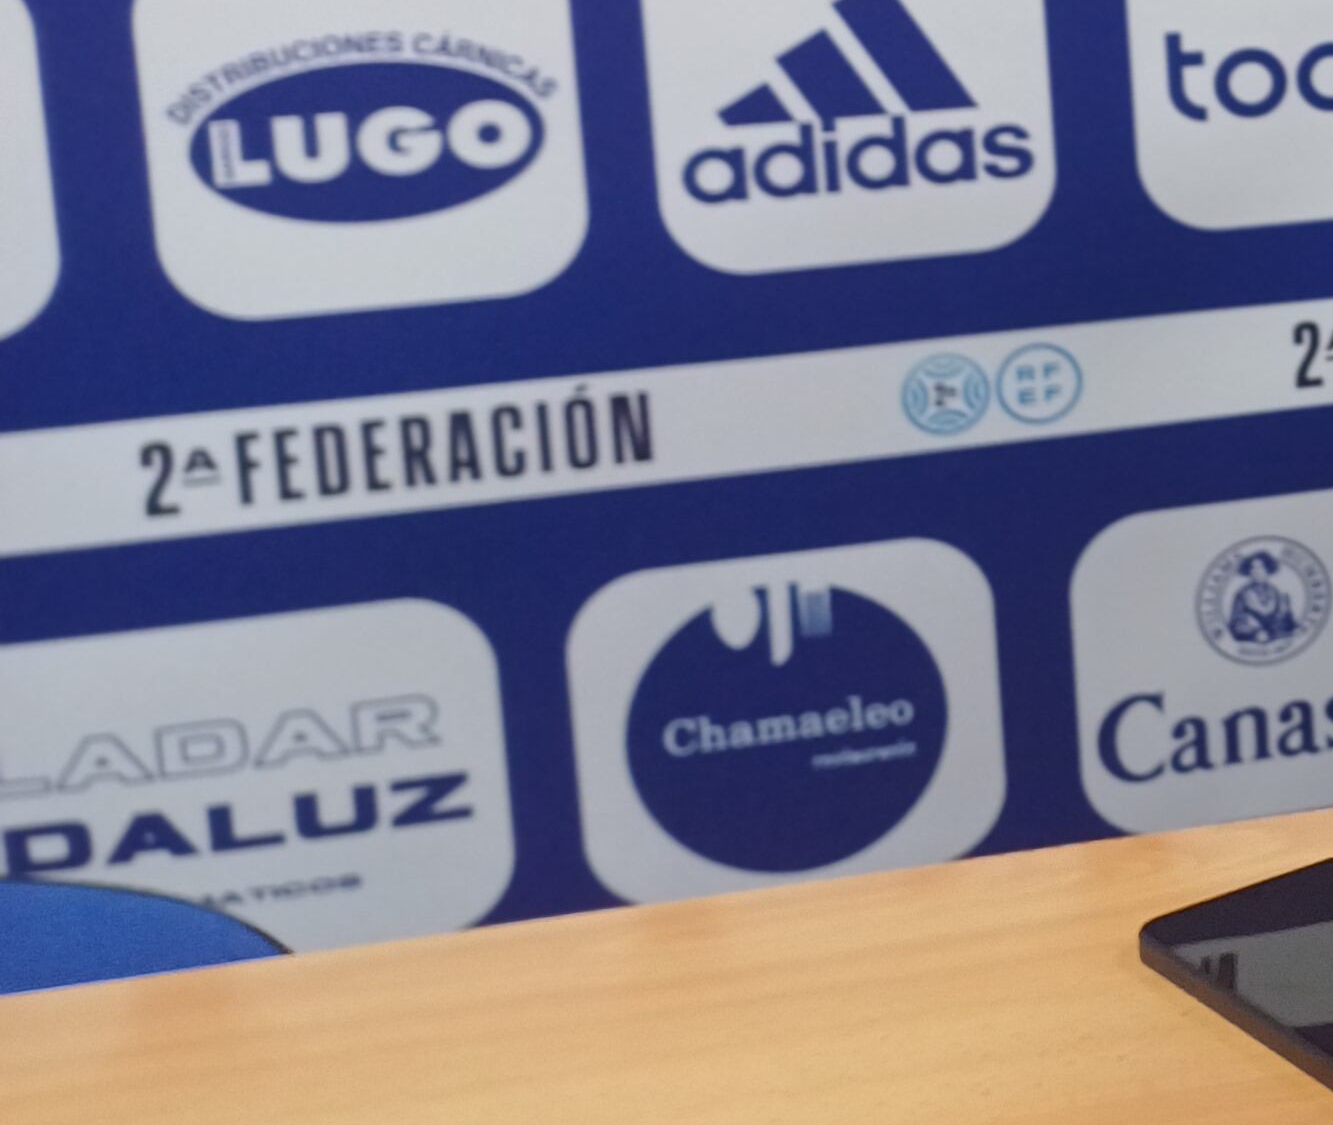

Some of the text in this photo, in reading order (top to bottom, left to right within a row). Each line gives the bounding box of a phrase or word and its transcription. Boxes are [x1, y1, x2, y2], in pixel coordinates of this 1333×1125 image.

[167, 31, 402, 125] DISTRIBUCIONES
[208, 98, 533, 189] LUGO
[682, 113, 1034, 205] adidas
[235, 385, 654, 505] FEDERACIÓN
[662, 695, 915, 758] Chamaeleo
